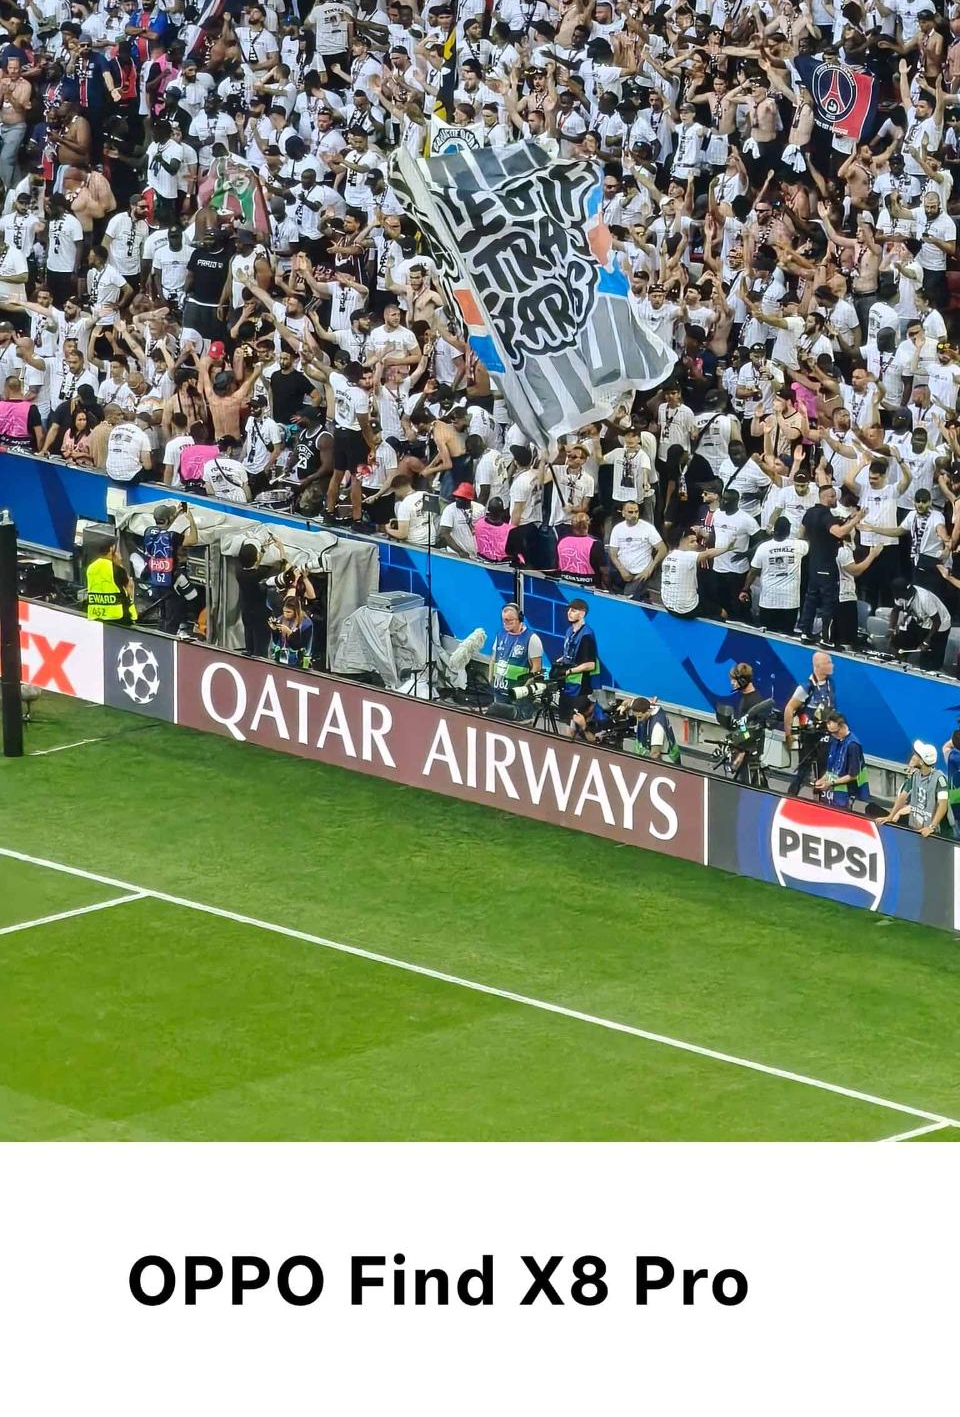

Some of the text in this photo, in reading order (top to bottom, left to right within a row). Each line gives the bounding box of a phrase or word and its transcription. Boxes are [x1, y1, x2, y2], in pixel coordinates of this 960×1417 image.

[201, 661, 679, 841] QATAR AIRWAYS
[779, 827, 878, 886] PEPSI
